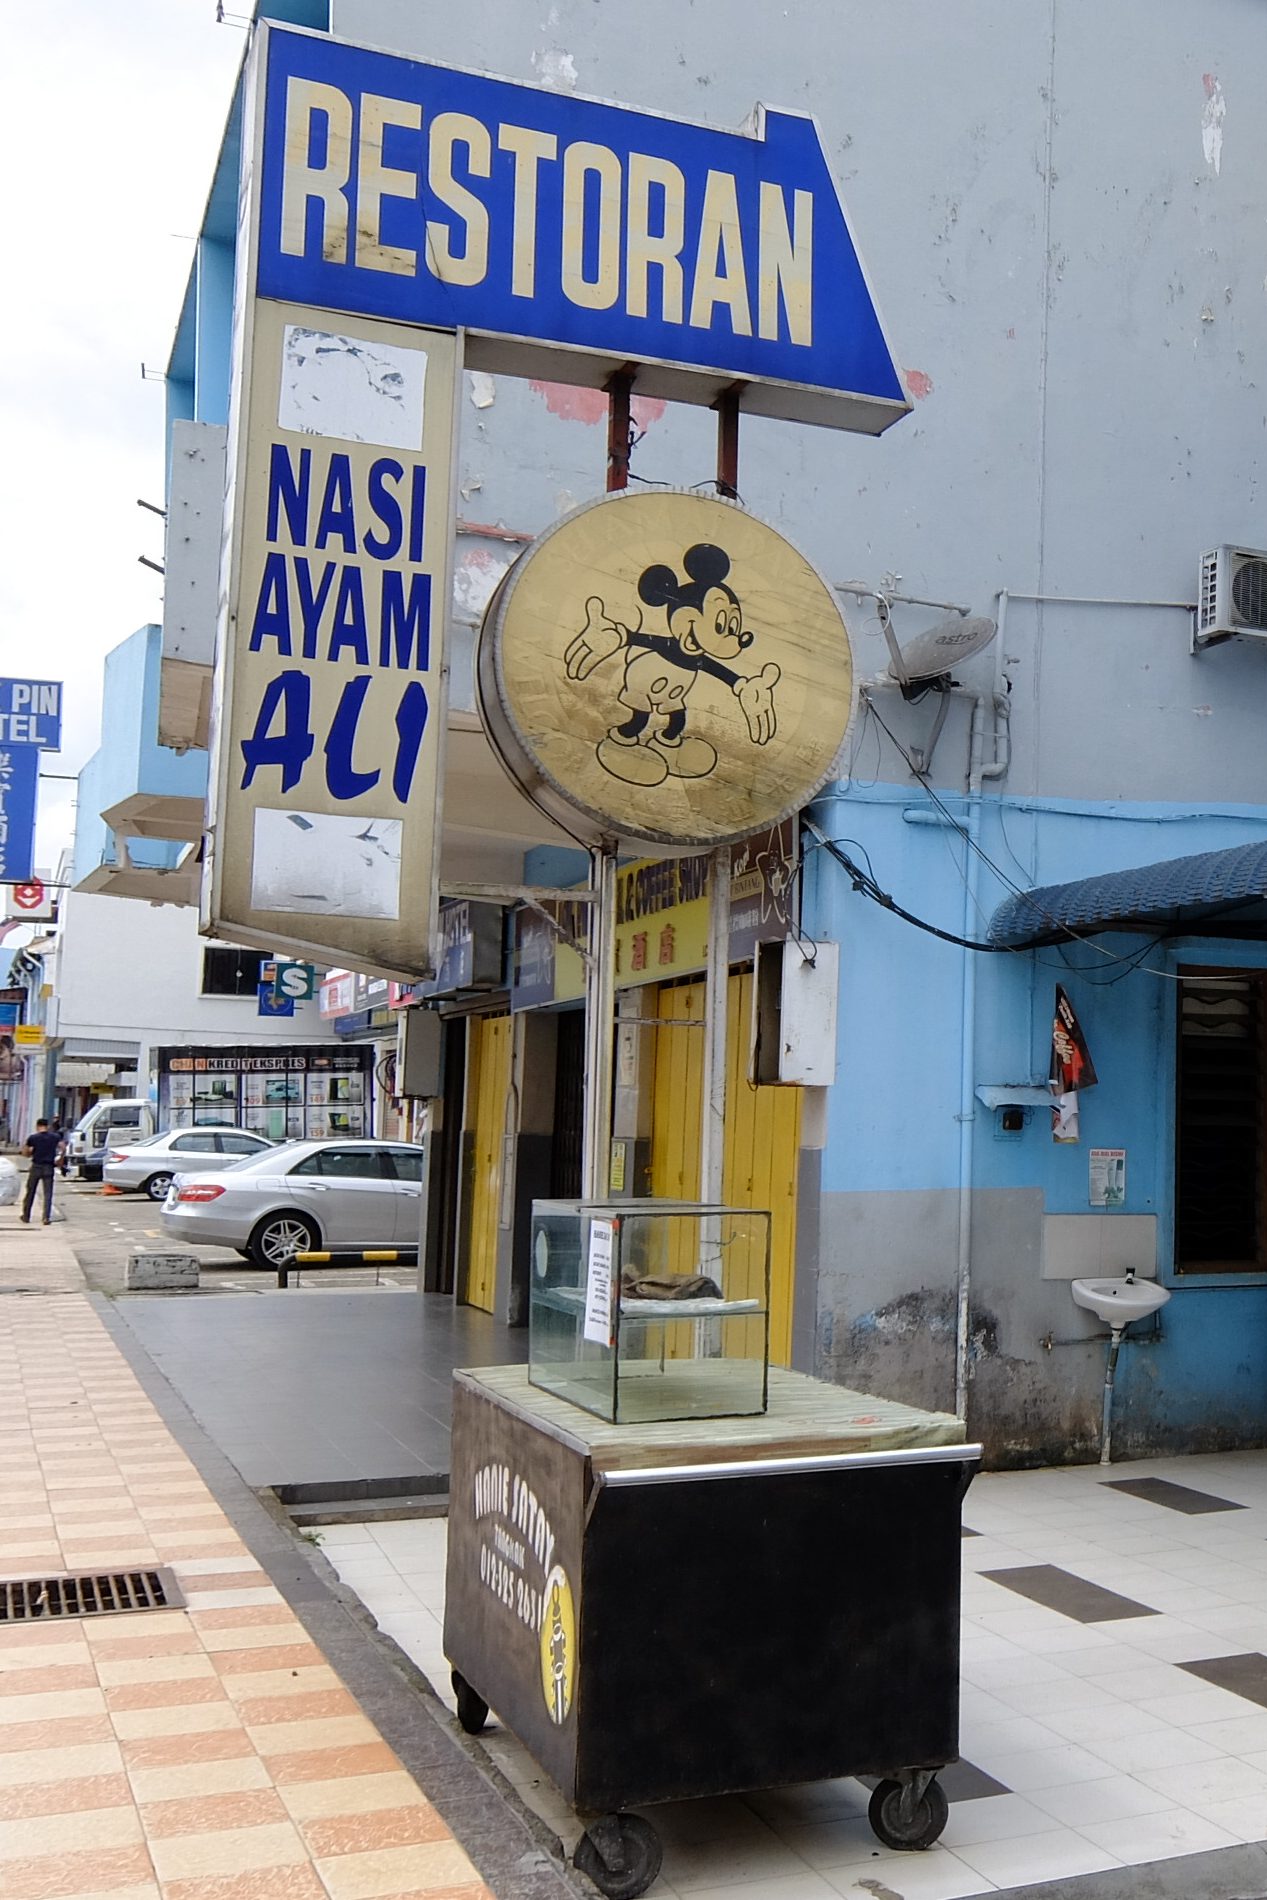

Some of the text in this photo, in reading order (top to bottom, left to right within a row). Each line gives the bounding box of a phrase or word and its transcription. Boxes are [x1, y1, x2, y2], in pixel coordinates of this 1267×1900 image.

[279, 75, 813, 348] RESTORAN
[265, 442, 427, 563] NASI
[248, 551, 432, 672] AYAM
[934, 630, 979, 647] astro
[11, 683, 58, 716] PIN
[240, 669, 428, 804] ALI
[208, 1058, 252, 1071] KREDT
[511, 1473, 555, 1580] SATAY
